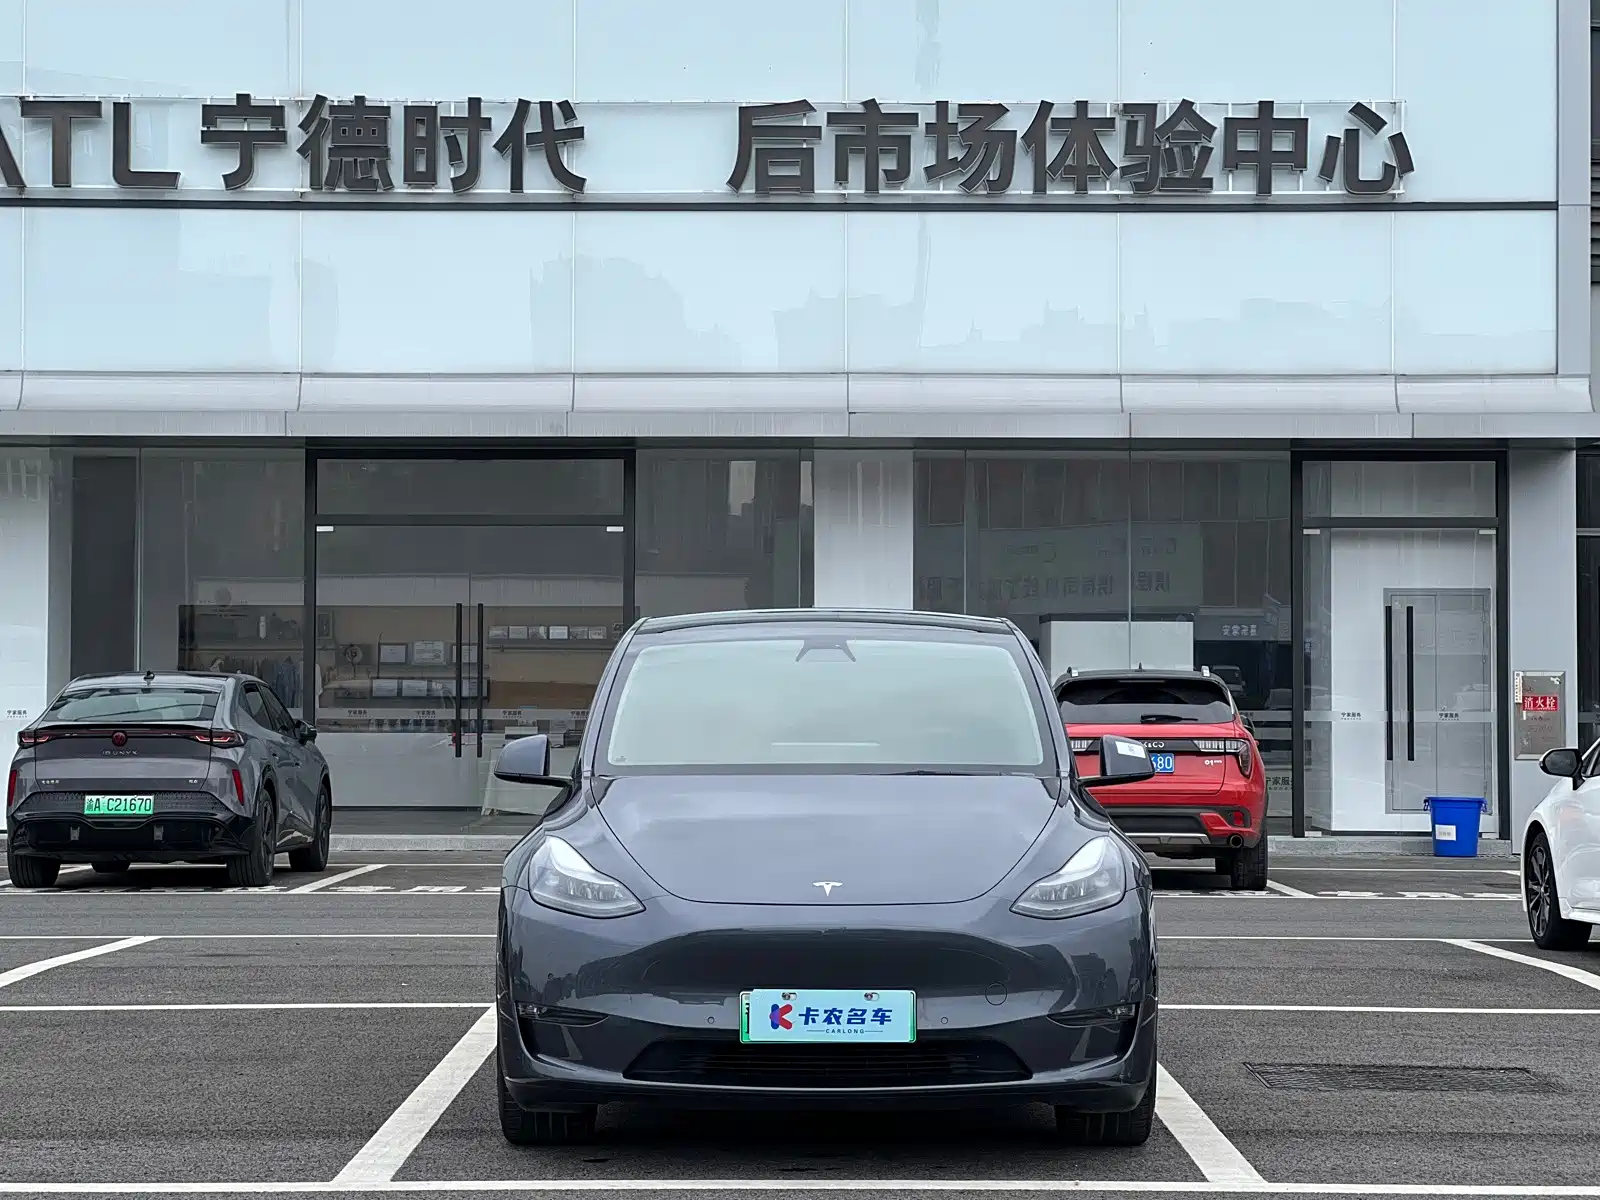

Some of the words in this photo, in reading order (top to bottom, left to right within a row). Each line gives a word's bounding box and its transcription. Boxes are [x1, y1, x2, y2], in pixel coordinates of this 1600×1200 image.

[200, 93, 587, 194] 宁德时代
[725, 98, 1414, 196] 后市场体验中心
[1524, 696, 1556, 708] 消火栓
[798, 1006, 893, 1026] 卡农名车
